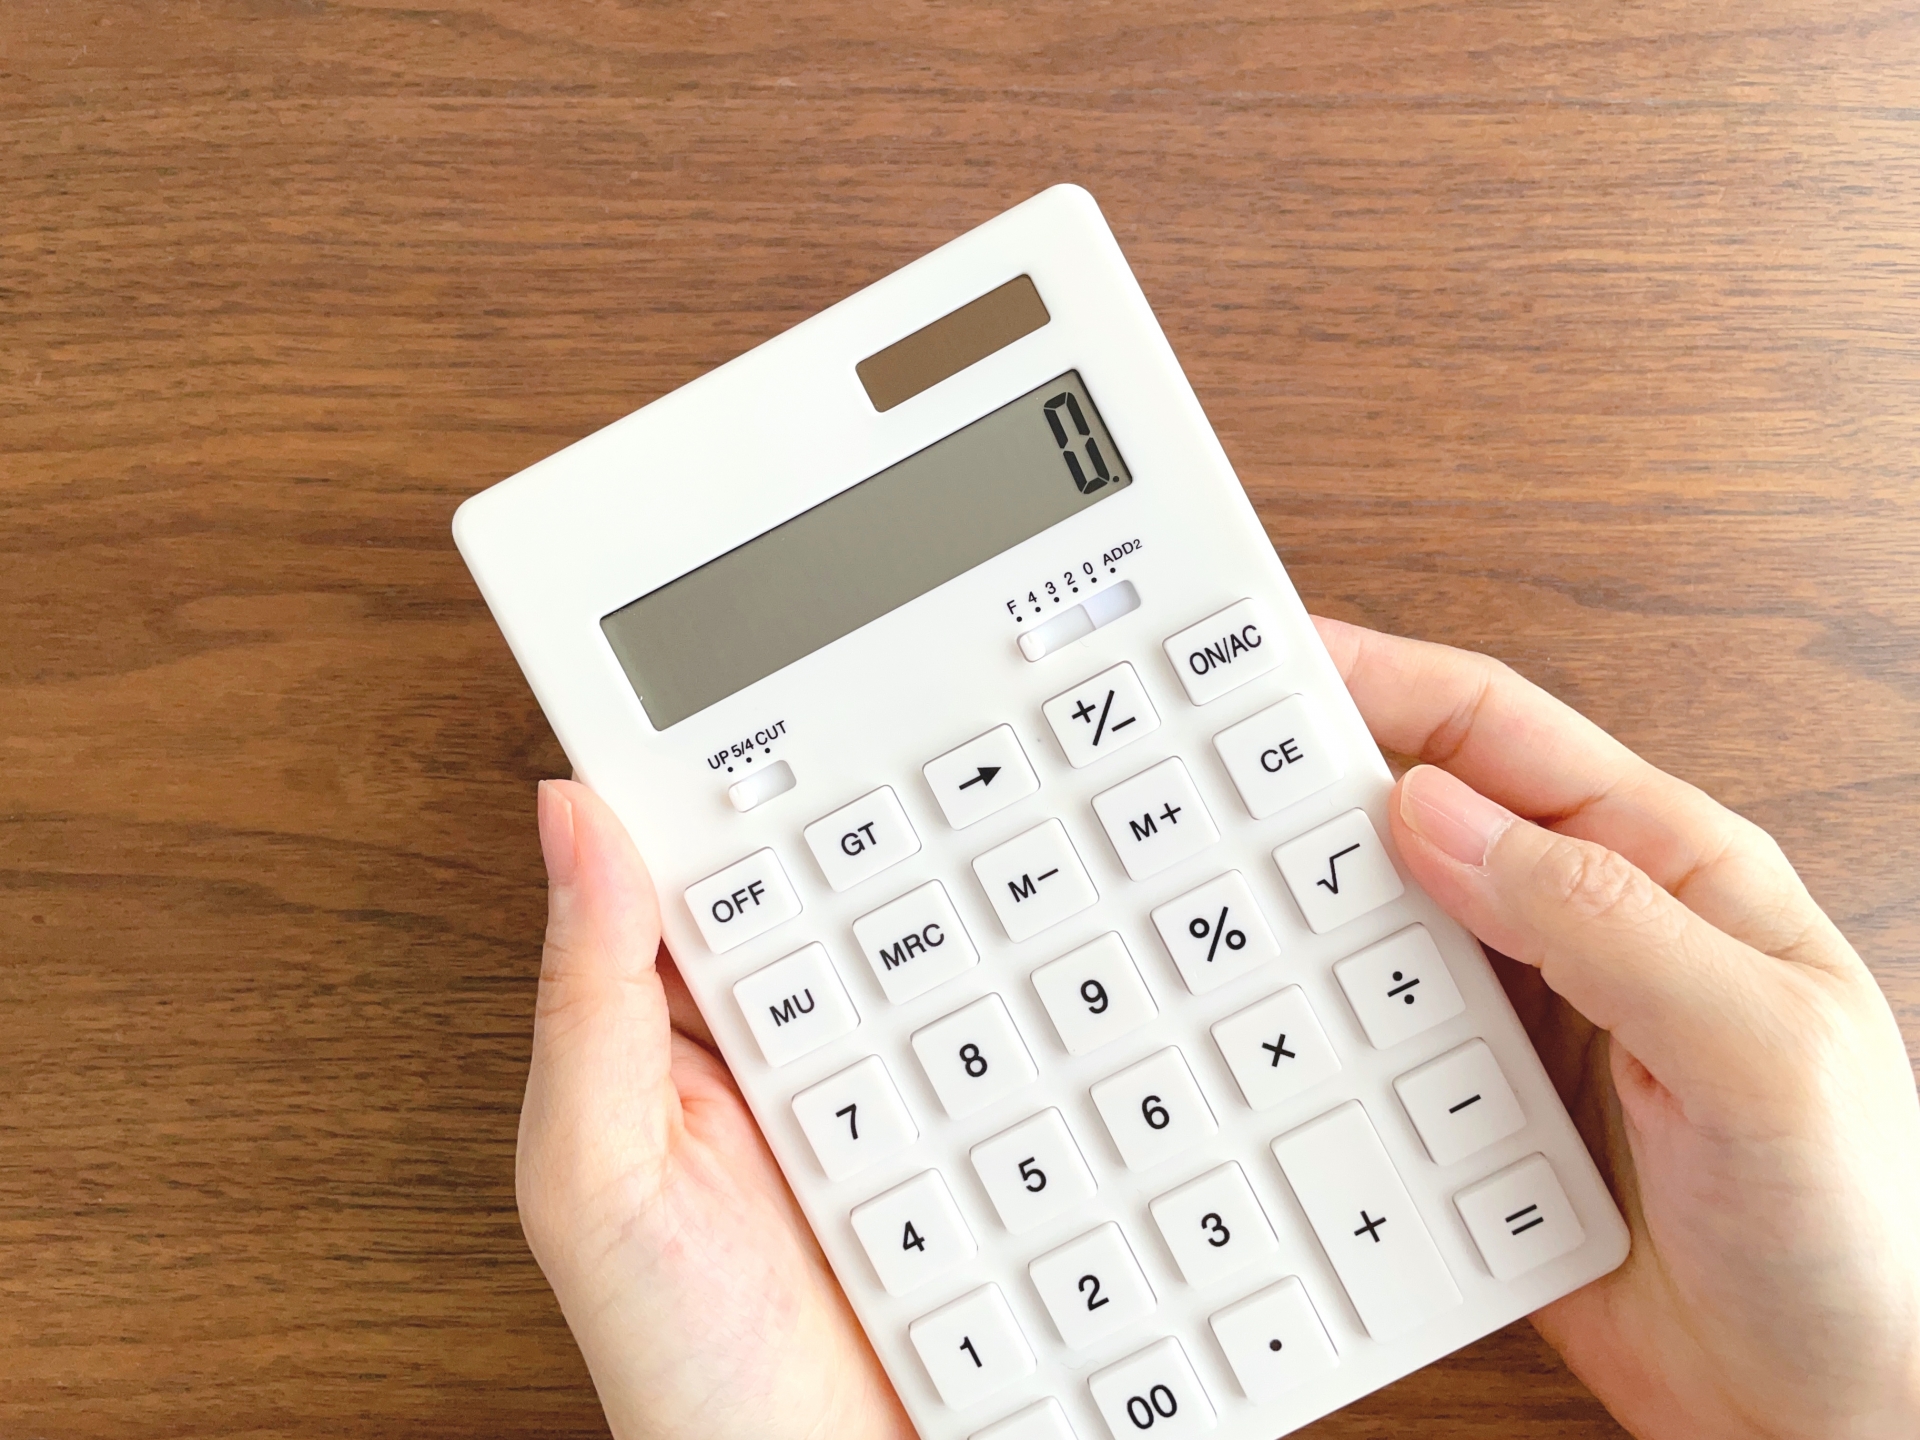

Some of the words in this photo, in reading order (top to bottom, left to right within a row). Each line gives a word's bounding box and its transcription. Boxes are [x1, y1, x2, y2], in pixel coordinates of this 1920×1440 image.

[1006, 599, 1018, 615] F
[1026, 590, 1038, 605] 4
[1044, 580, 1057, 595] 3
[1063, 571, 1076, 586] 2
[1082, 561, 1094, 576] 0
[1189, 624, 1263, 676] ON/AC
[706, 750, 730, 770] UP
[730, 737, 755, 758] 5/4
[754, 719, 787, 746] CUT
[1260, 737, 1305, 773] CE
[841, 821, 879, 856] GT
[1129, 802, 1182, 842] M+
[712, 880, 766, 923] OFF
[879, 922, 946, 971] MRC
[1189, 906, 1247, 963] %
[769, 988, 816, 1027] MU
[1080, 979, 1109, 1014] 9
[959, 1043, 988, 1078] 8
[835, 1103, 859, 1140] 7
[1141, 1095, 1170, 1130] 6
[1018, 1156, 1047, 1193] 5
[901, 1220, 925, 1253] 4
[1201, 1212, 1230, 1248] 3
[1078, 1274, 1111, 1312] 2
[959, 1335, 984, 1368] 1
[1126, 1384, 1178, 1430] 00
